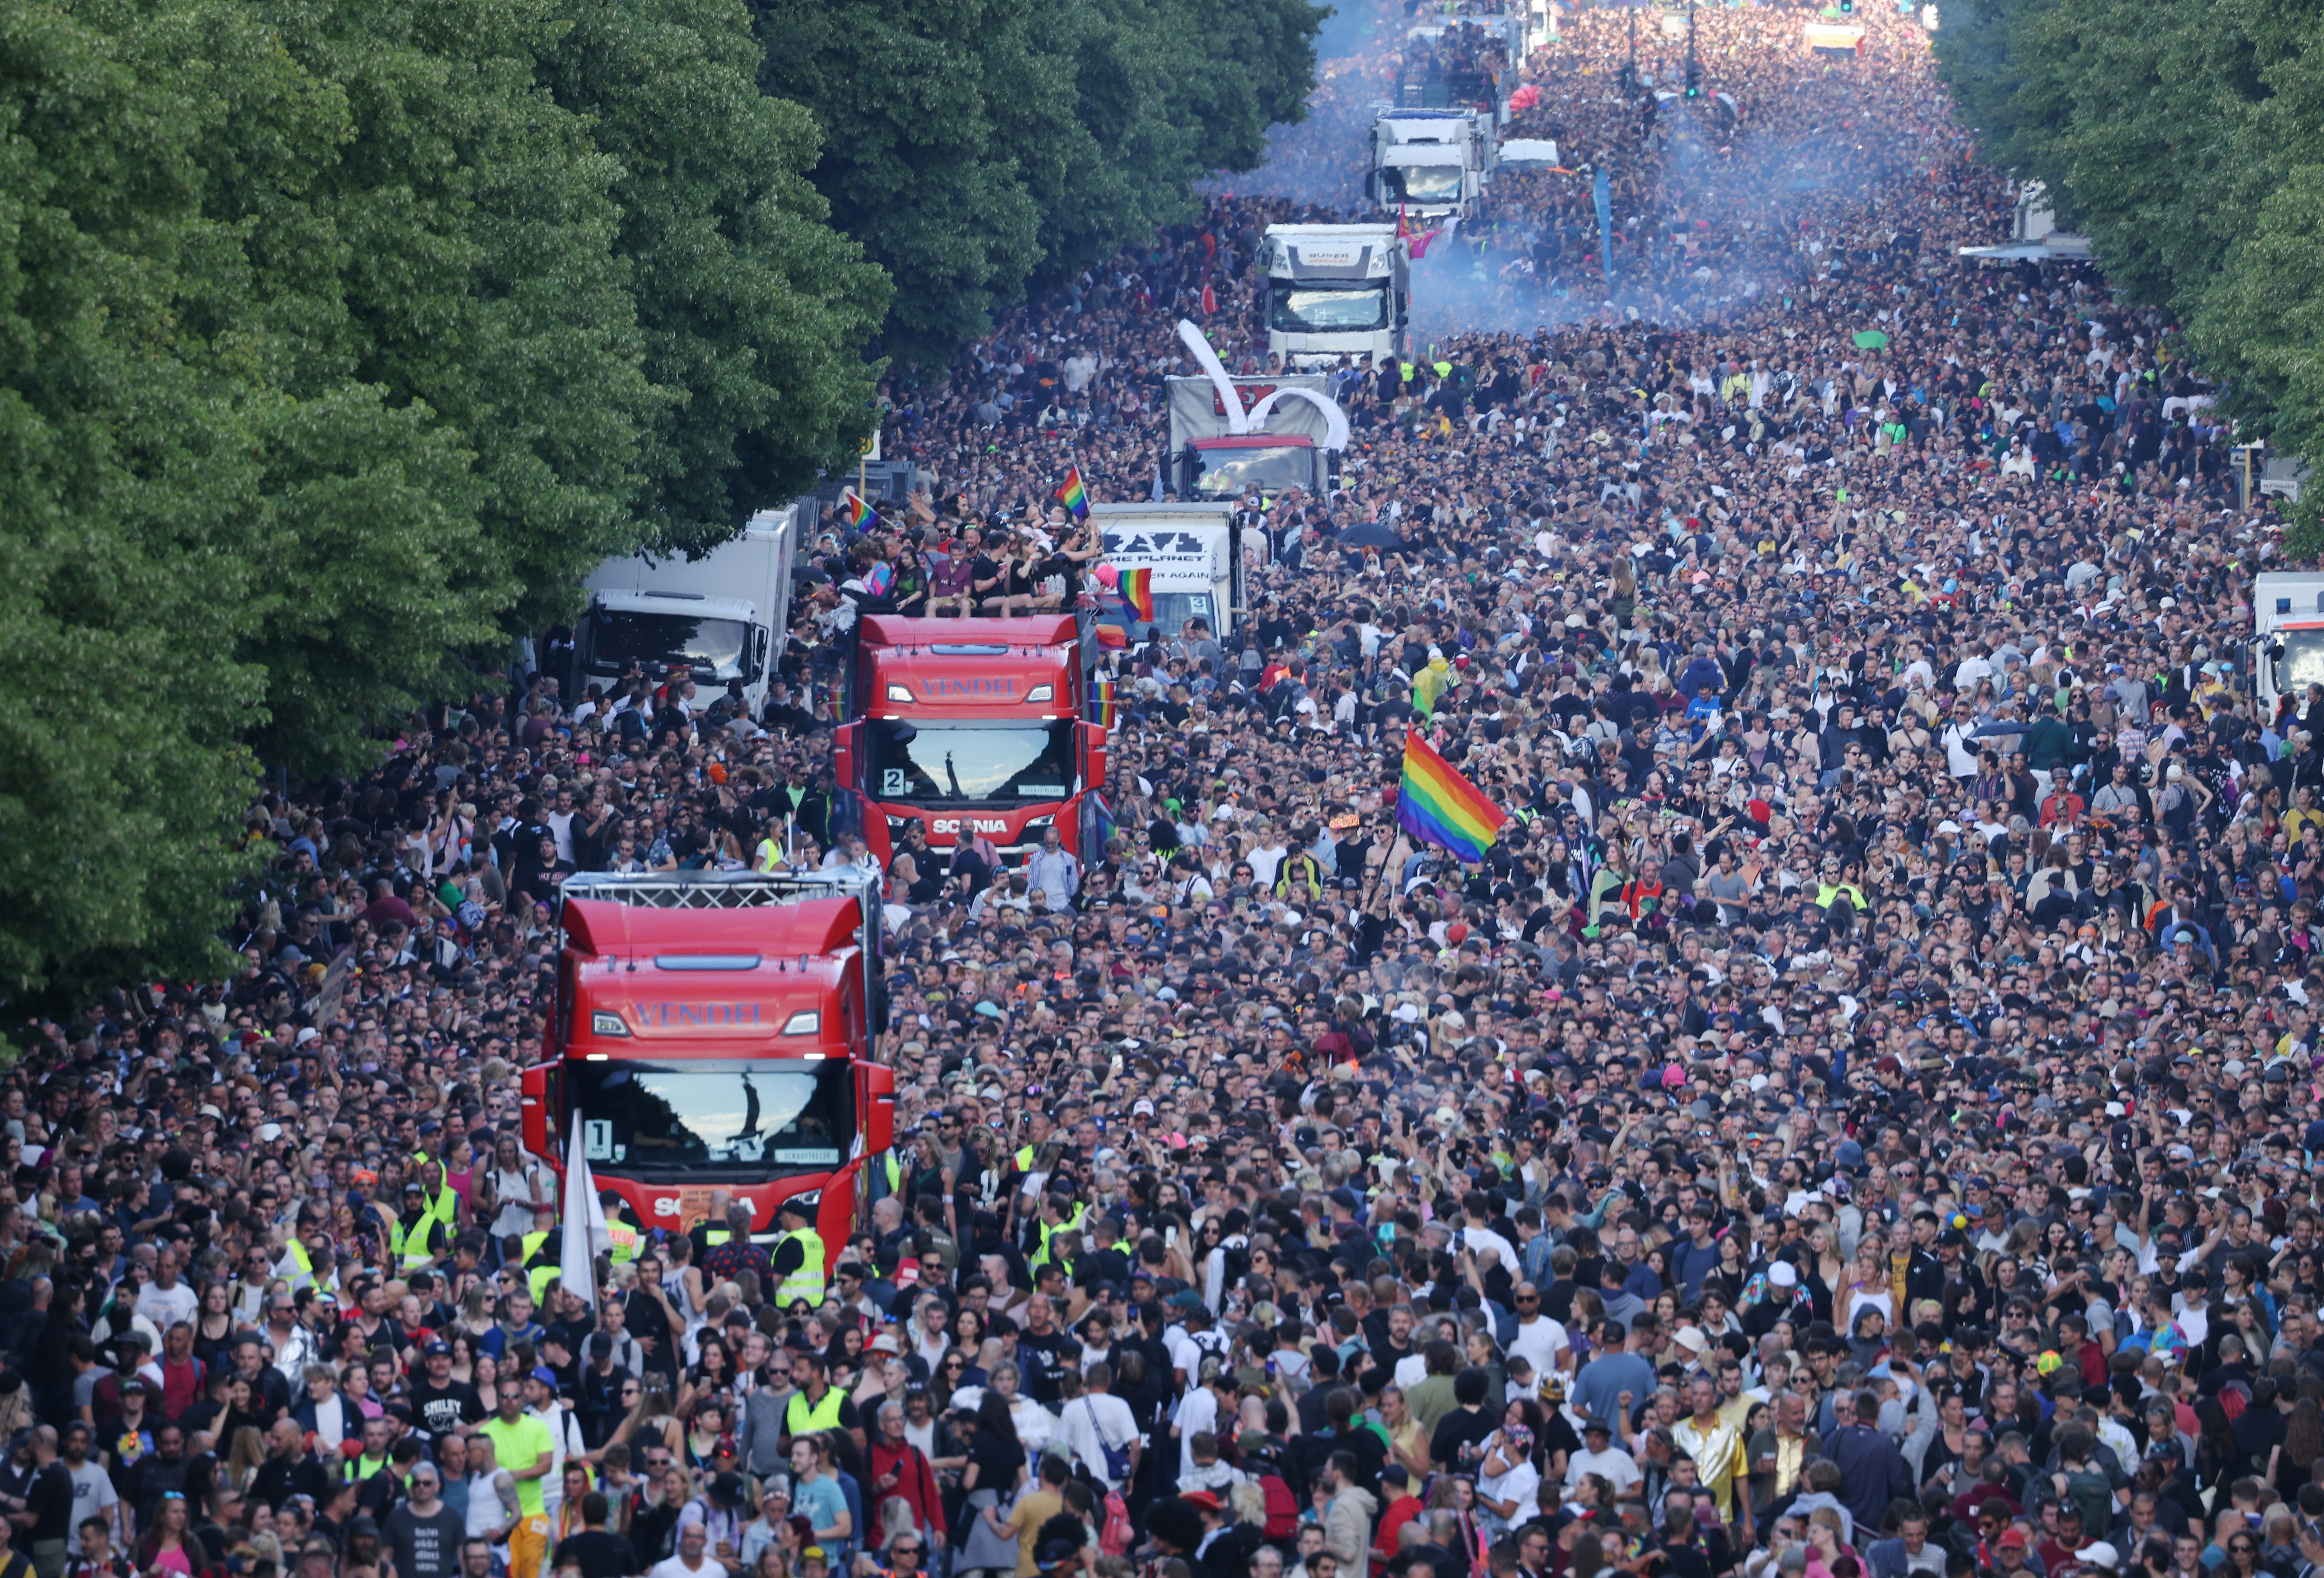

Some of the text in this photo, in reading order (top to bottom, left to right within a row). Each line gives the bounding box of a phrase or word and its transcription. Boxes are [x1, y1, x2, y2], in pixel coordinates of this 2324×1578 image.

[1192, 597, 1204, 608] 3
[922, 677, 1019, 697] VENDEL
[887, 771, 901, 788] 2
[933, 819, 1008, 833] SCNIA
[592, 1123, 603, 1146] 1
[424, 1398, 462, 1418] SMILEY
